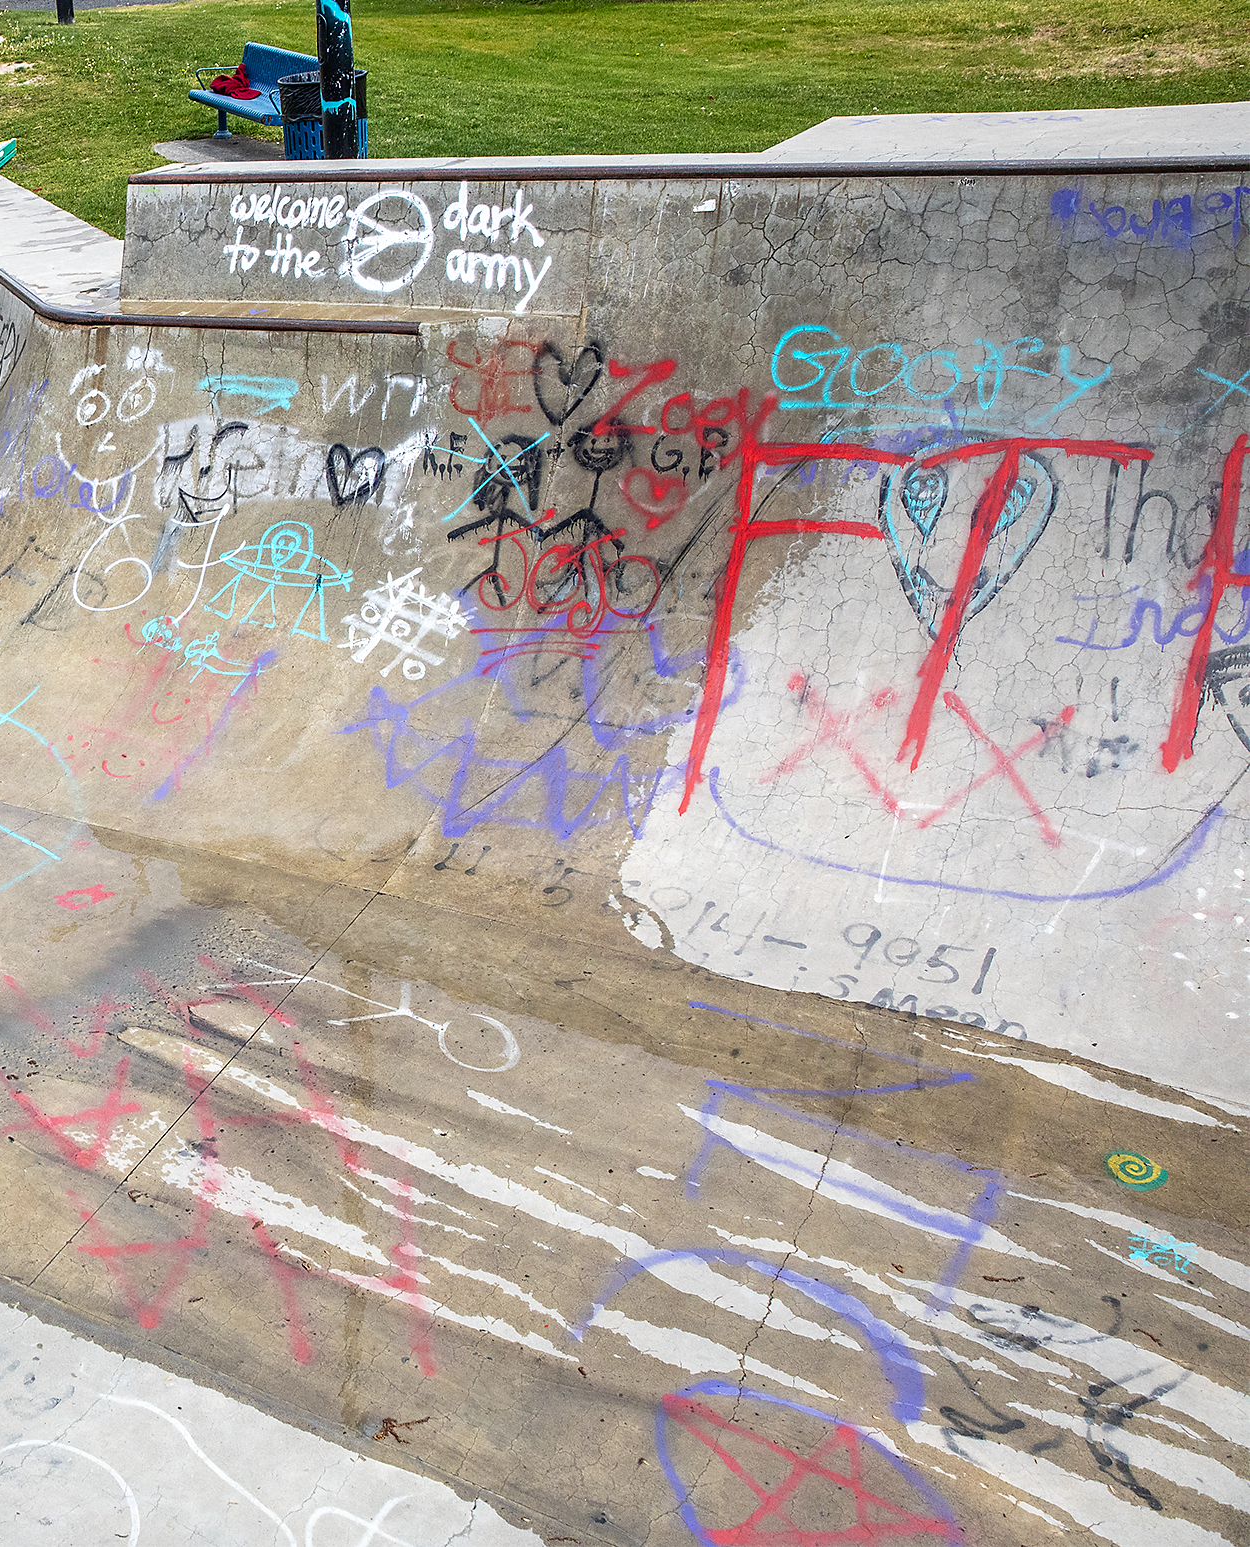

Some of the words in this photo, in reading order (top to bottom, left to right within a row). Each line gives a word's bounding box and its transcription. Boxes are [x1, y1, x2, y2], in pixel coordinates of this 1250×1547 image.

[229, 186, 347, 229] welcome
[442, 180, 545, 248] dark
[222, 231, 261, 276] to
[264, 231, 326, 279] the
[444, 246, 553, 314] army
